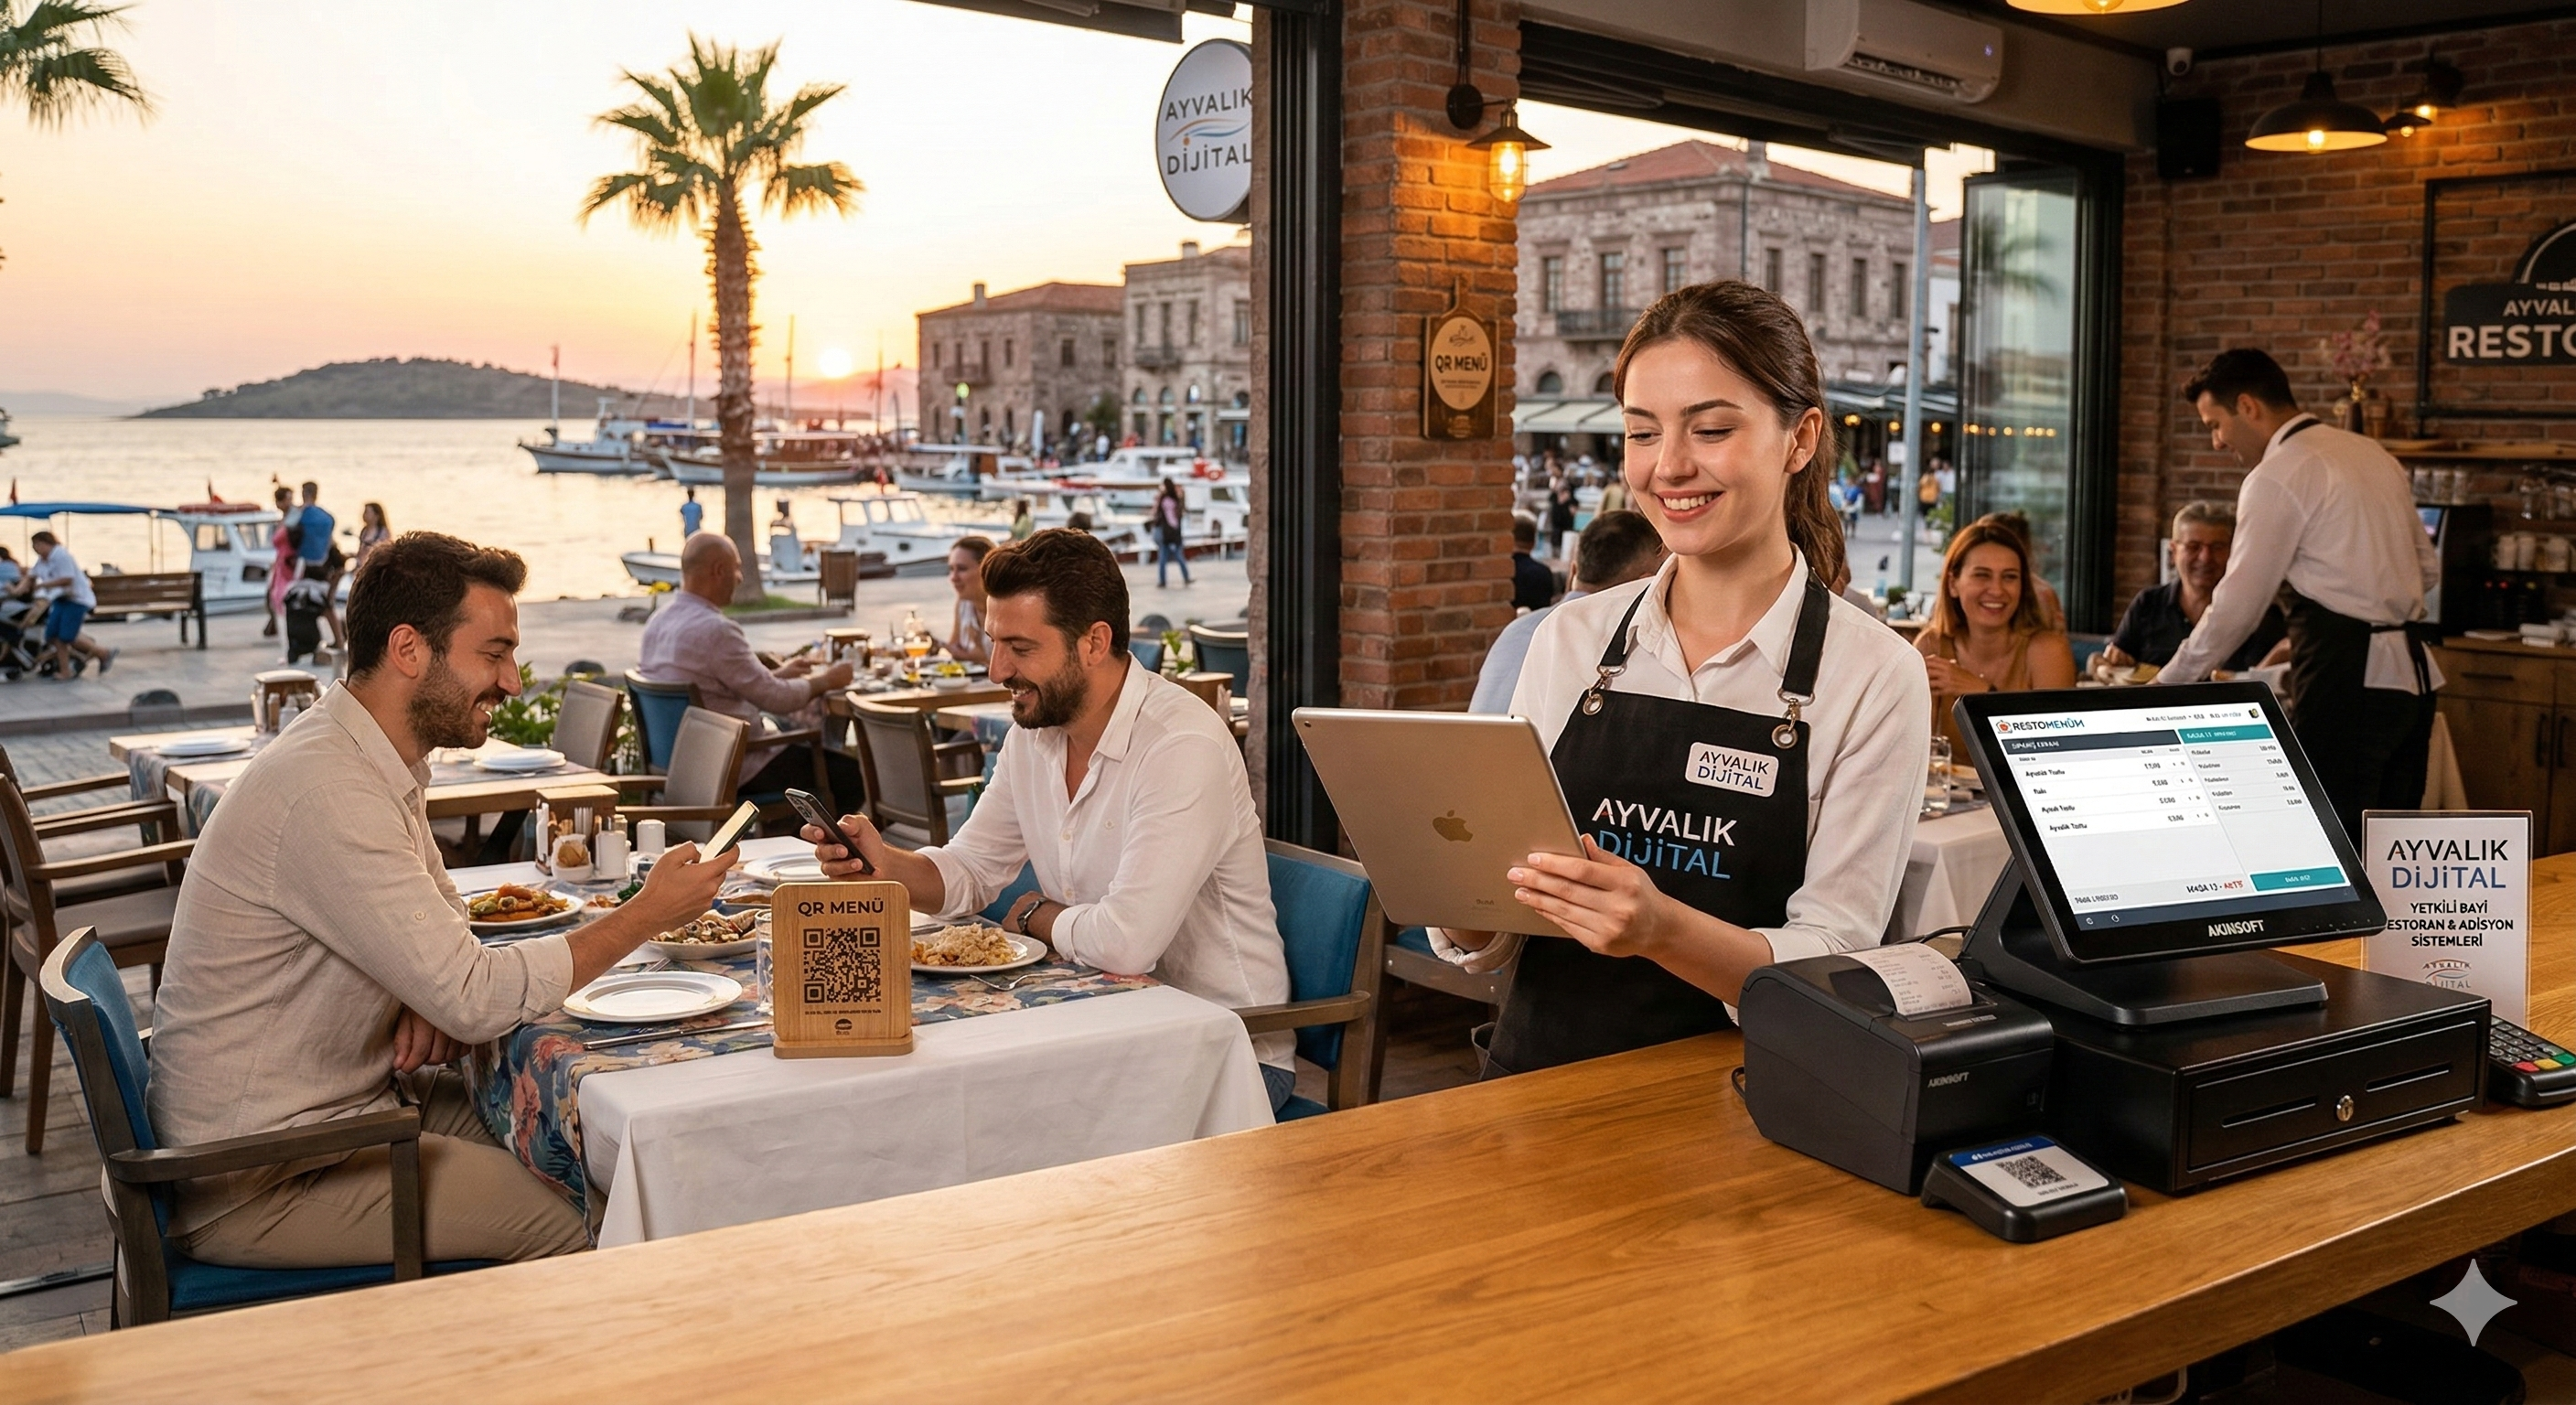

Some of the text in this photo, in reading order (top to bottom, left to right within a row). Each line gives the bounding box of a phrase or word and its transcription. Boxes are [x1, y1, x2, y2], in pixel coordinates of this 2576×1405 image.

[1165, 88, 1252, 122] AYVALIK
[2503, 299, 2576, 316] AYVAL
[1435, 355, 1453, 373] QR
[1699, 750, 1770, 775] AYVALIK
[1592, 798, 1737, 846] AYVALIK
[2387, 839, 2508, 861] AYVALIK
[798, 897, 884, 917] QR MENÜ
[2410, 899, 2488, 914] YETKİLİ BAYİ
[2207, 919, 2265, 938] AKINSOFT
[2387, 917, 2514, 930] ESTORAN & ADİSYON
[2411, 933, 2483, 947] SİSTEMLERİ
